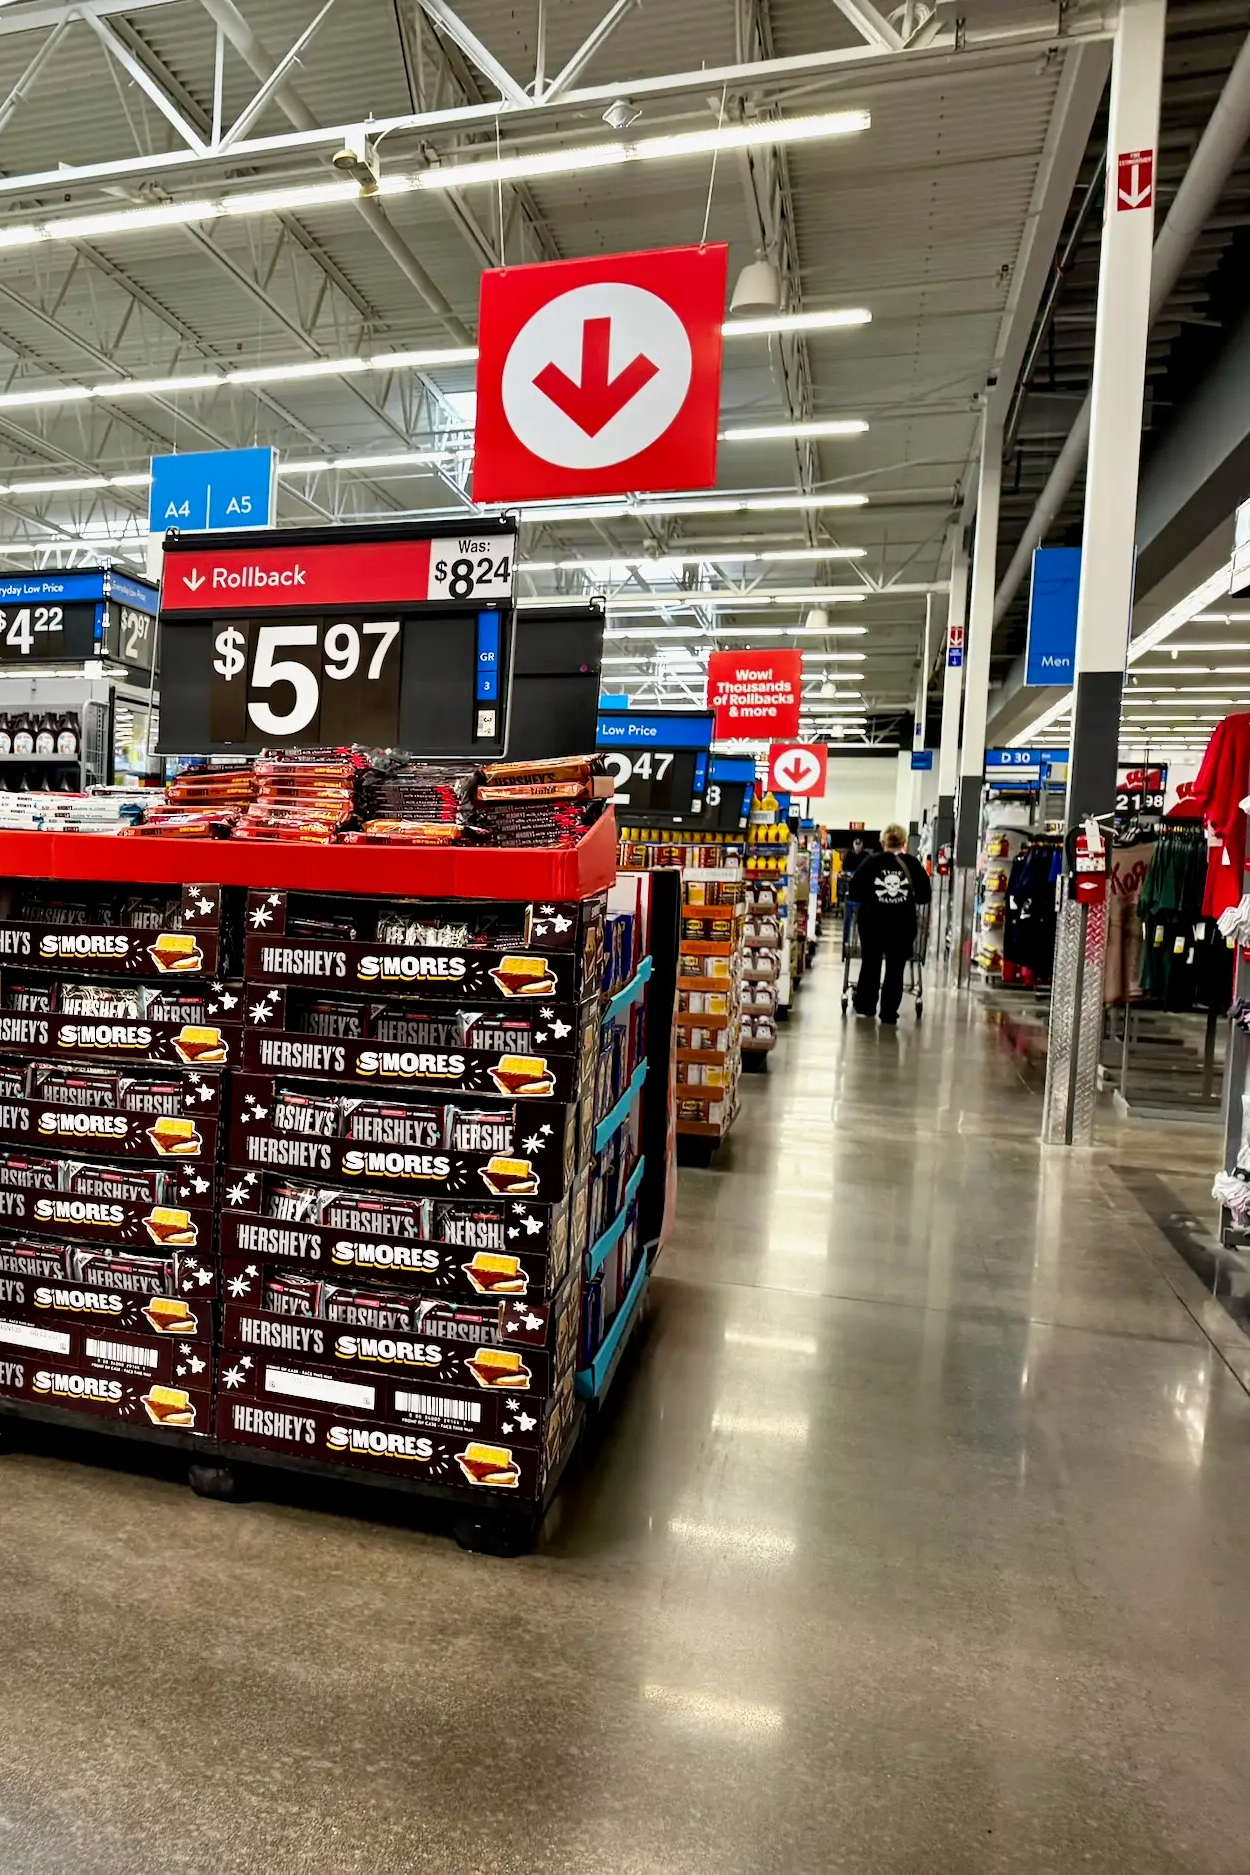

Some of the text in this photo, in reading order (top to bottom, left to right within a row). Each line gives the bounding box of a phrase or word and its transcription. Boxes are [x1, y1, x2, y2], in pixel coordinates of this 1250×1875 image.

[164, 500, 191, 518] A4
[226, 496, 252, 514] A5
[458, 539, 491, 554] Was:
[23, 584, 40, 594] Low
[42, 582, 64, 593] Price
[212, 564, 306, 590] Rollback
[479, 652, 495, 661] GR
[1041, 656, 1070, 668] Men
[484, 681, 491, 690] 3
[736, 669, 773, 680] Wow!
[713, 692, 794, 705] of Rollbacks
[717, 681, 791, 693] Thousands
[729, 706, 777, 717] & more
[602, 724, 657, 737] Low Price
[1015, 752, 1030, 763] 30
[41, 935, 129, 956] S'MORES
[261, 947, 466, 981] HERSHEY'S S'MORES
[58, 1025, 152, 1048] S'MORES
[261, 1040, 465, 1078] HERSHEY'S S'MORES
[39, 1113, 128, 1138] S'MORES
[274, 1103, 336, 1136] RSHEY'S
[352, 1115, 437, 1146] HERSHEY'S
[453, 1123, 513, 1152] HERSHE
[247, 1136, 450, 1180] HERSHEY'S S'MORES
[34, 1200, 124, 1226] S'MORES
[237, 1227, 439, 1273] HERSHEY'S S'MORES
[34, 1287, 123, 1315] S'MORES
[240, 1317, 442, 1367] HERSHEY'S S'MORES
[33, 1371, 122, 1402] S'MORES
[234, 1406, 433, 1462] HERSHEY'S S'MORES
